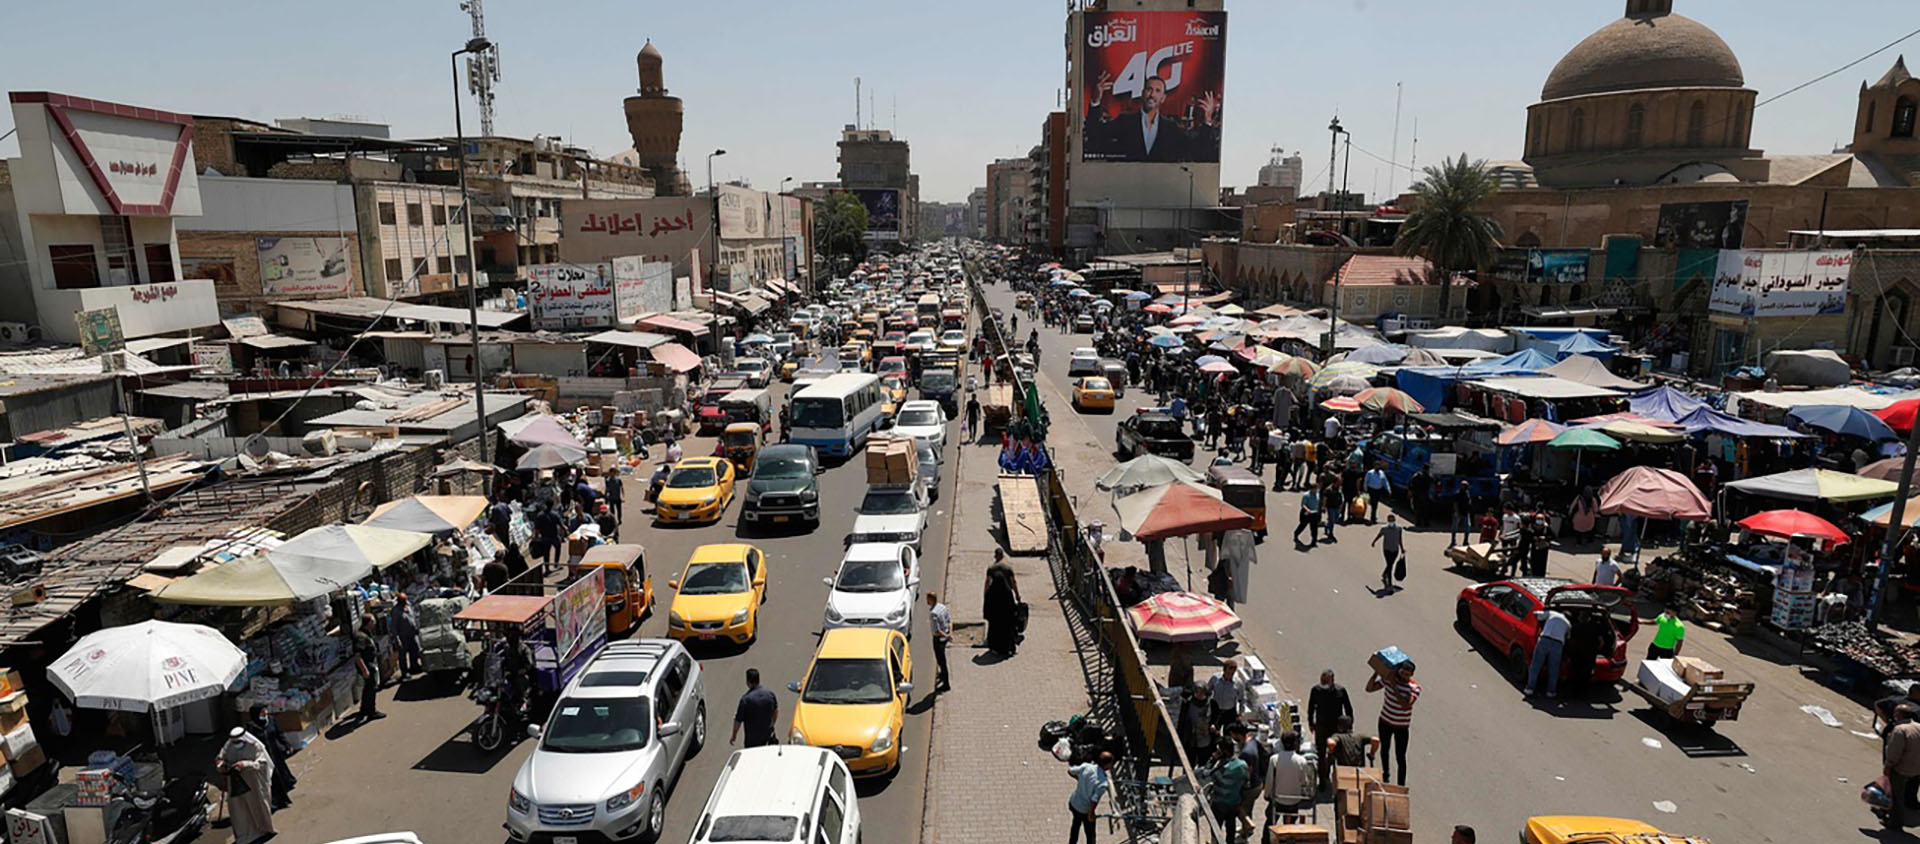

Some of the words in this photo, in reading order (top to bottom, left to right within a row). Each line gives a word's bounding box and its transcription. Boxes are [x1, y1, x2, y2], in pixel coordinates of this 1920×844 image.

[1088, 24, 1137, 47] العراق
[1174, 41, 1195, 56] LTE
[530, 280, 541, 293] 2
[577, 283, 612, 299] مصطفى
[1761, 274, 1812, 297] السوداني
[1815, 276, 1845, 290] حيدر
[163, 668, 200, 690] PINE
